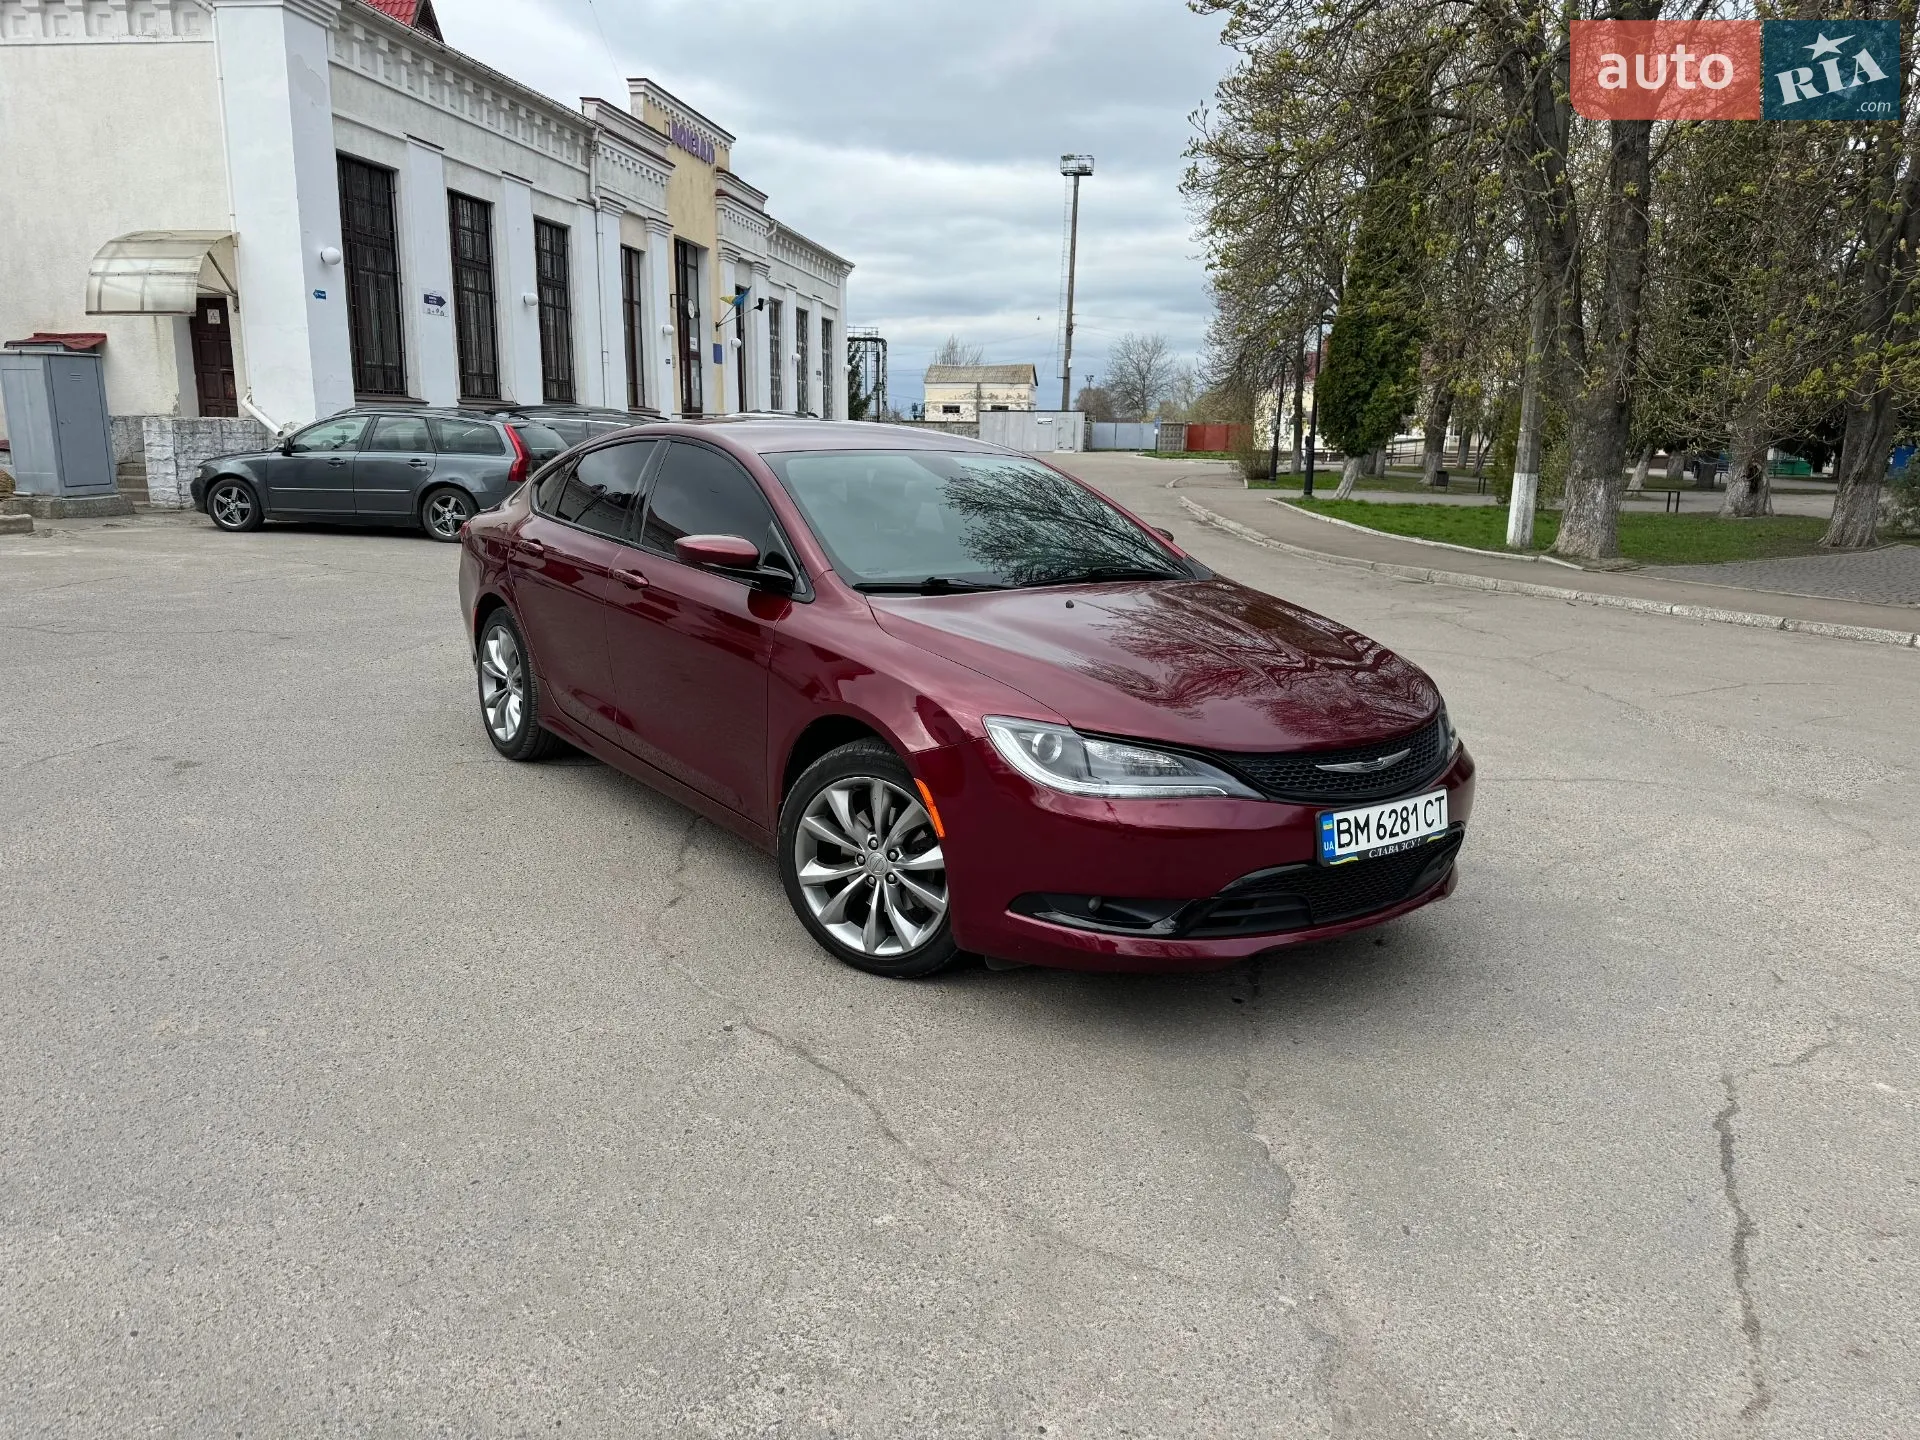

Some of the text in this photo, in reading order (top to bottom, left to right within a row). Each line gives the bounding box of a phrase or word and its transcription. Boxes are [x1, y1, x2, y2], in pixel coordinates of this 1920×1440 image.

[1336, 795, 1445, 849] BM 6281 CT
[1323, 841, 1335, 851] UA
[1368, 843, 1399, 859] СЛАВА
